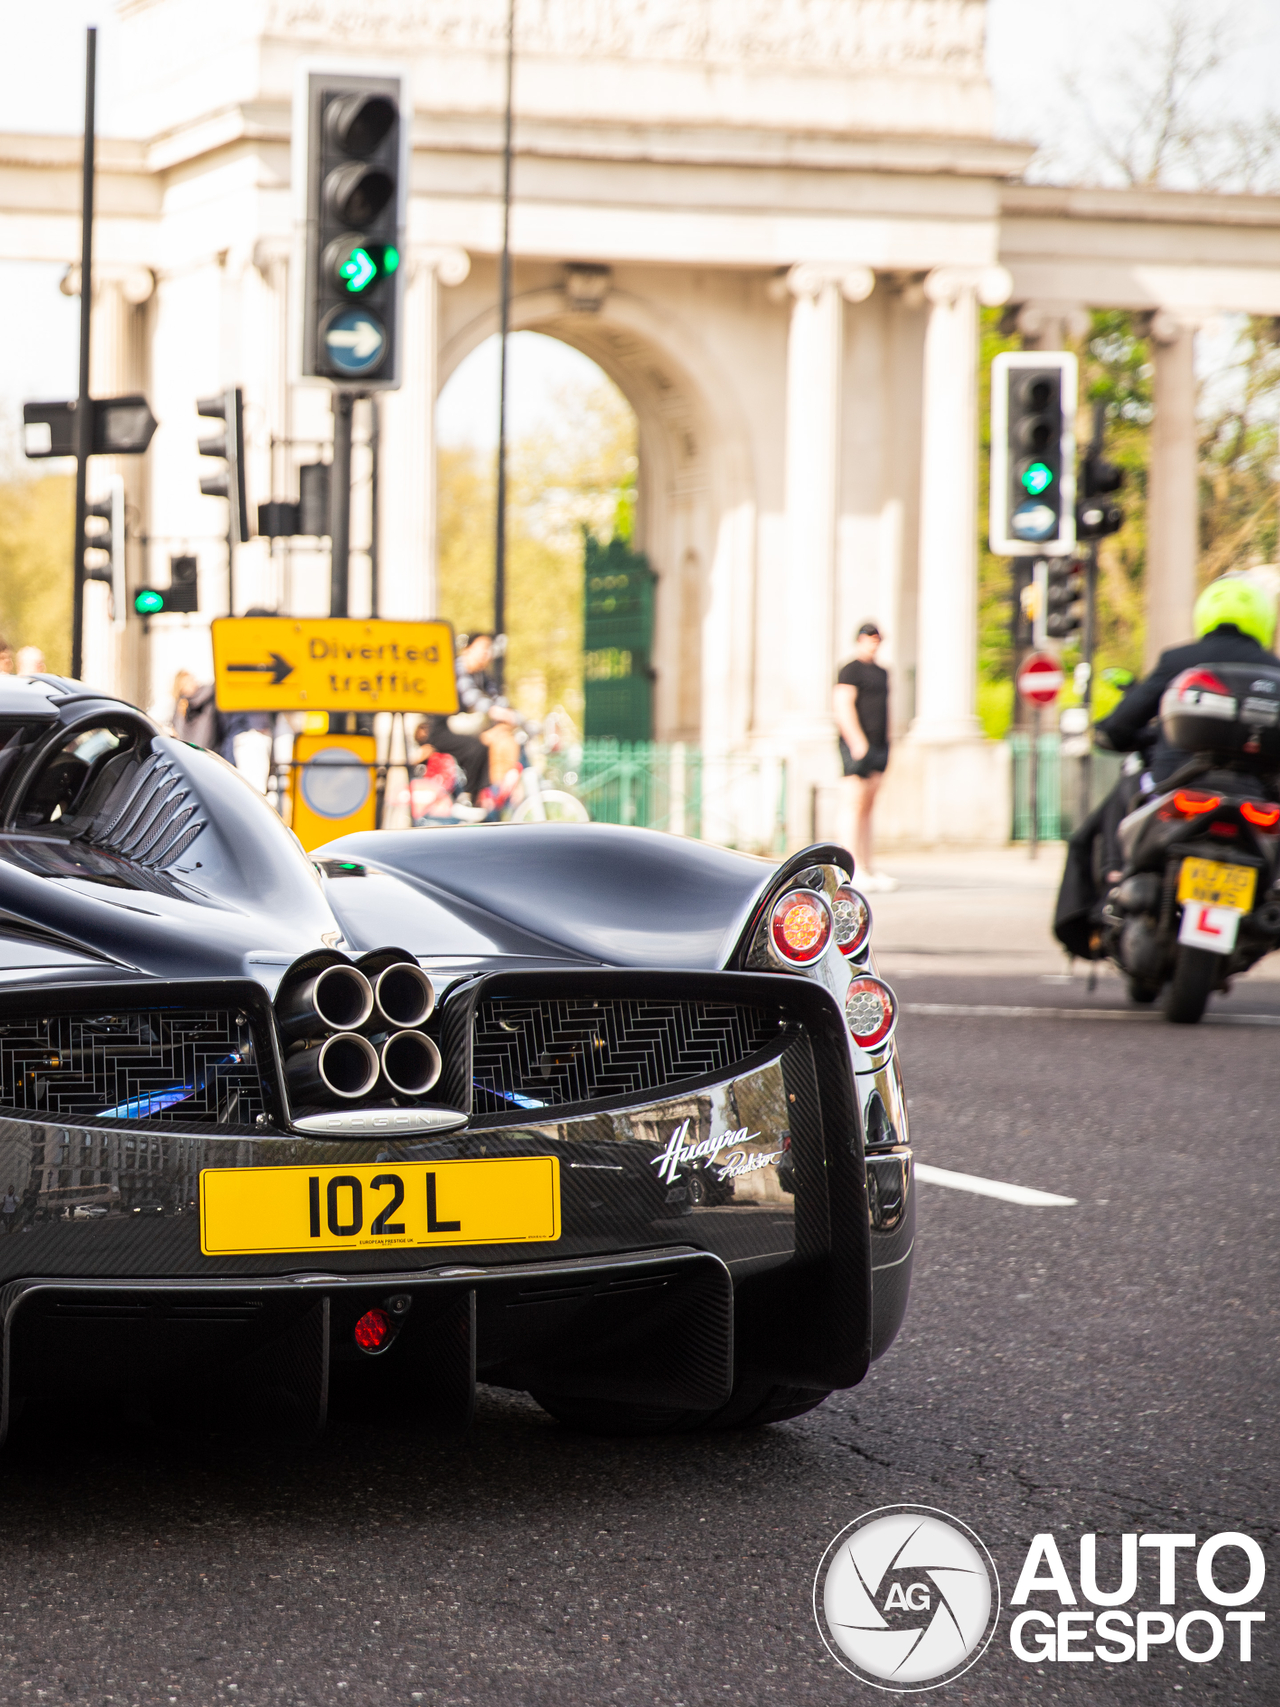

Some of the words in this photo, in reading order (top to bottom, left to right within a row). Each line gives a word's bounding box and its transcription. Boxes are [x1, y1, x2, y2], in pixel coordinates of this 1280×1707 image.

[309, 637, 440, 663] Diverted
[329, 672, 427, 694] traffic
[1197, 907, 1221, 935] L
[326, 1113, 442, 1129] PAGANI
[650, 1118, 761, 1185] Huayra
[425, 1172, 461, 1233] L
